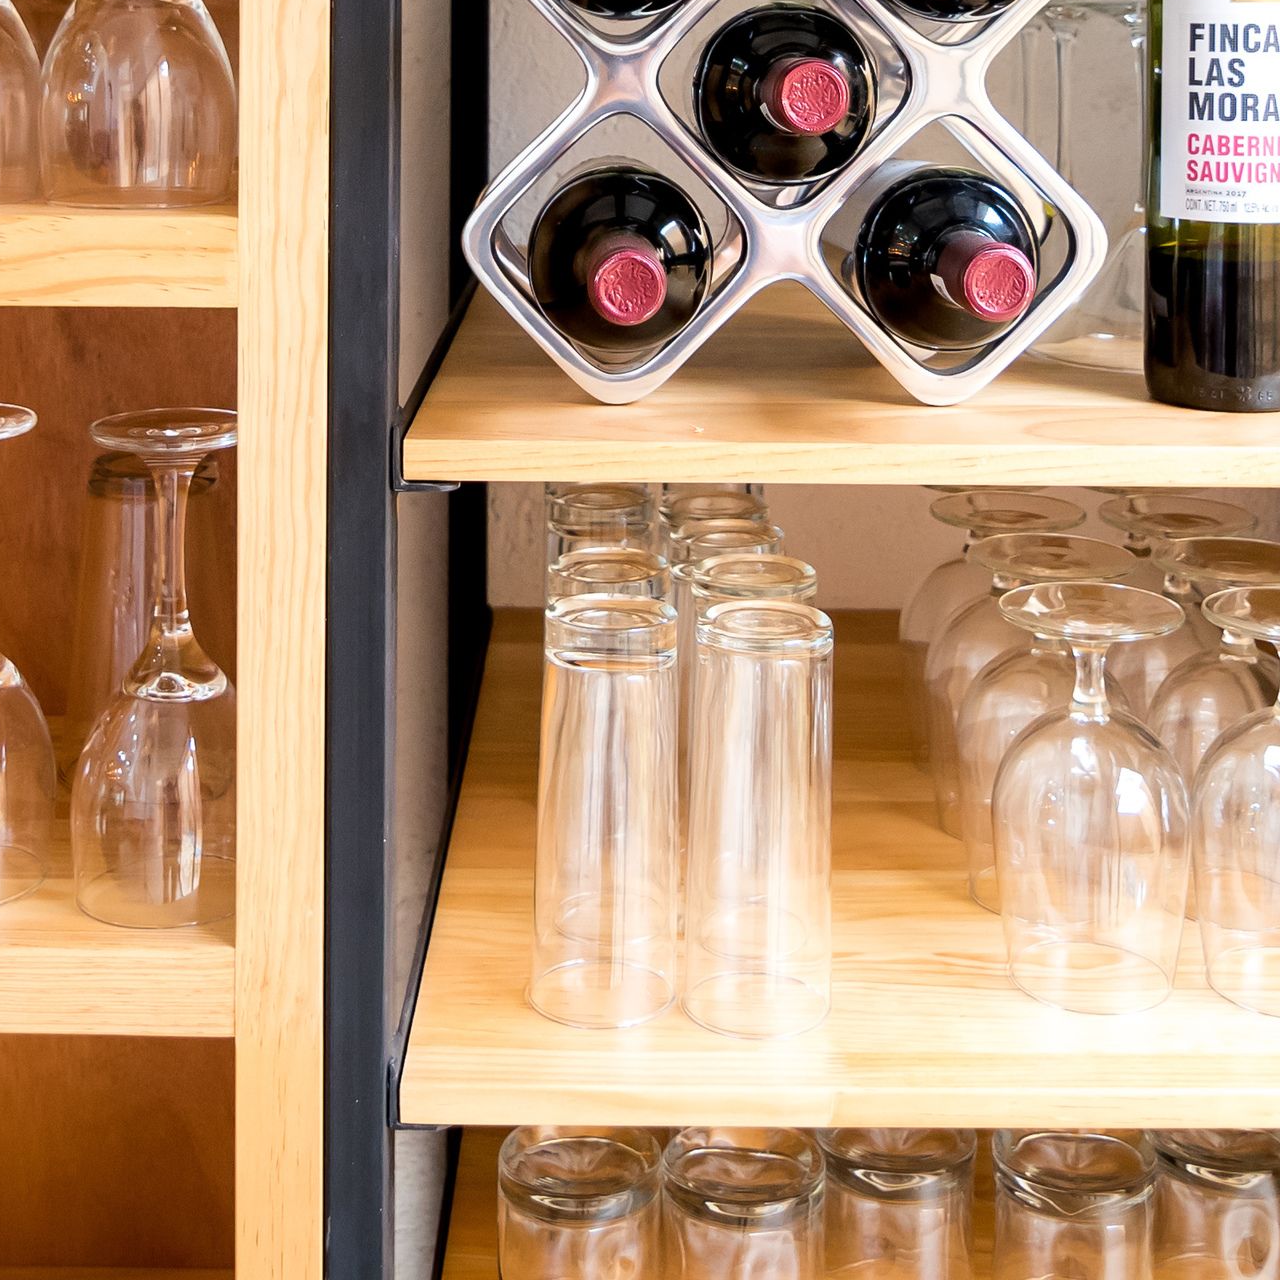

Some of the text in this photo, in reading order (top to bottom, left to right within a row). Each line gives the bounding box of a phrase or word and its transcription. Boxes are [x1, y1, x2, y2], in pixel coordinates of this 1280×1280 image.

[1189, 23, 1280, 53] FINCA
[1188, 57, 1246, 88] LAS
[1225, 190, 1247, 198] 2017
